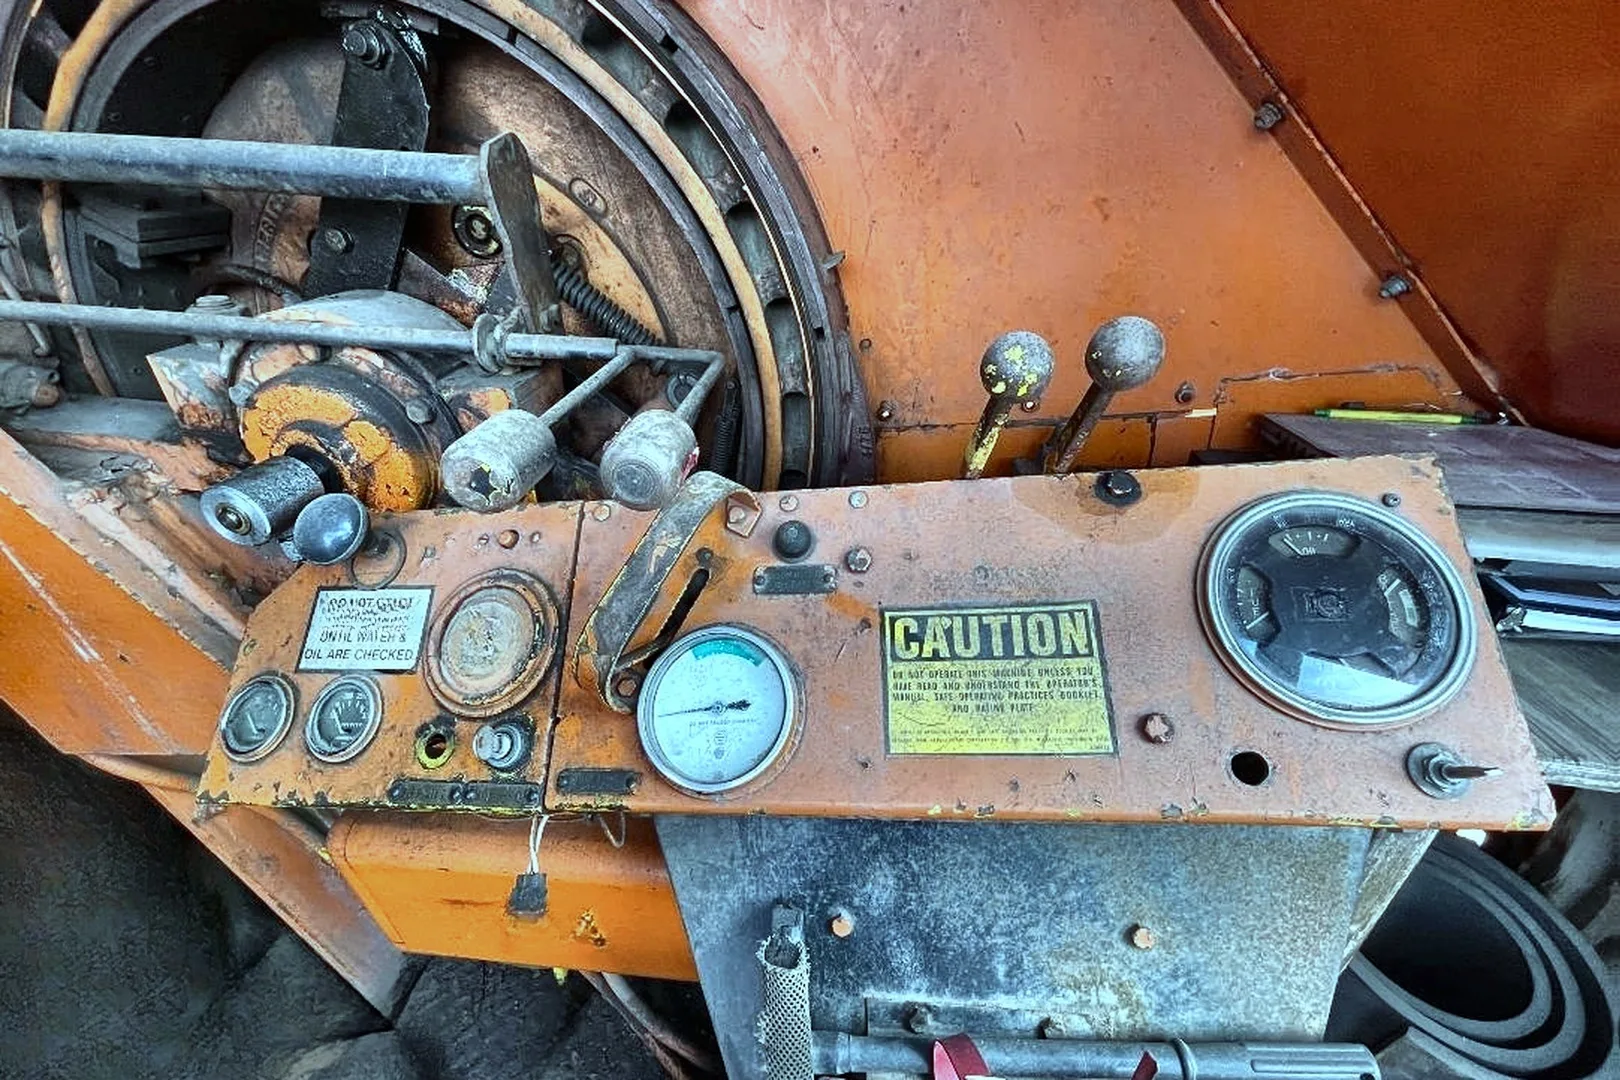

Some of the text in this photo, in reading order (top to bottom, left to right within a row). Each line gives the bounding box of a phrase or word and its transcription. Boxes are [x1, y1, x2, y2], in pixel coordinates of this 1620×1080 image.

[320, 627, 353, 643] UNTIL
[356, 627, 394, 643] WATER
[893, 611, 1090, 660] CAUTION
[304, 649, 322, 660] OIL
[326, 649, 351, 660] ARE
[928, 670, 963, 679] OPERATE
[1038, 667, 1071, 677] UNLESS
[917, 681, 938, 691] READ
[943, 681, 960, 691] AND
[934, 692, 954, 702] SAFE
[1007, 690, 1054, 701] PRACTICES
